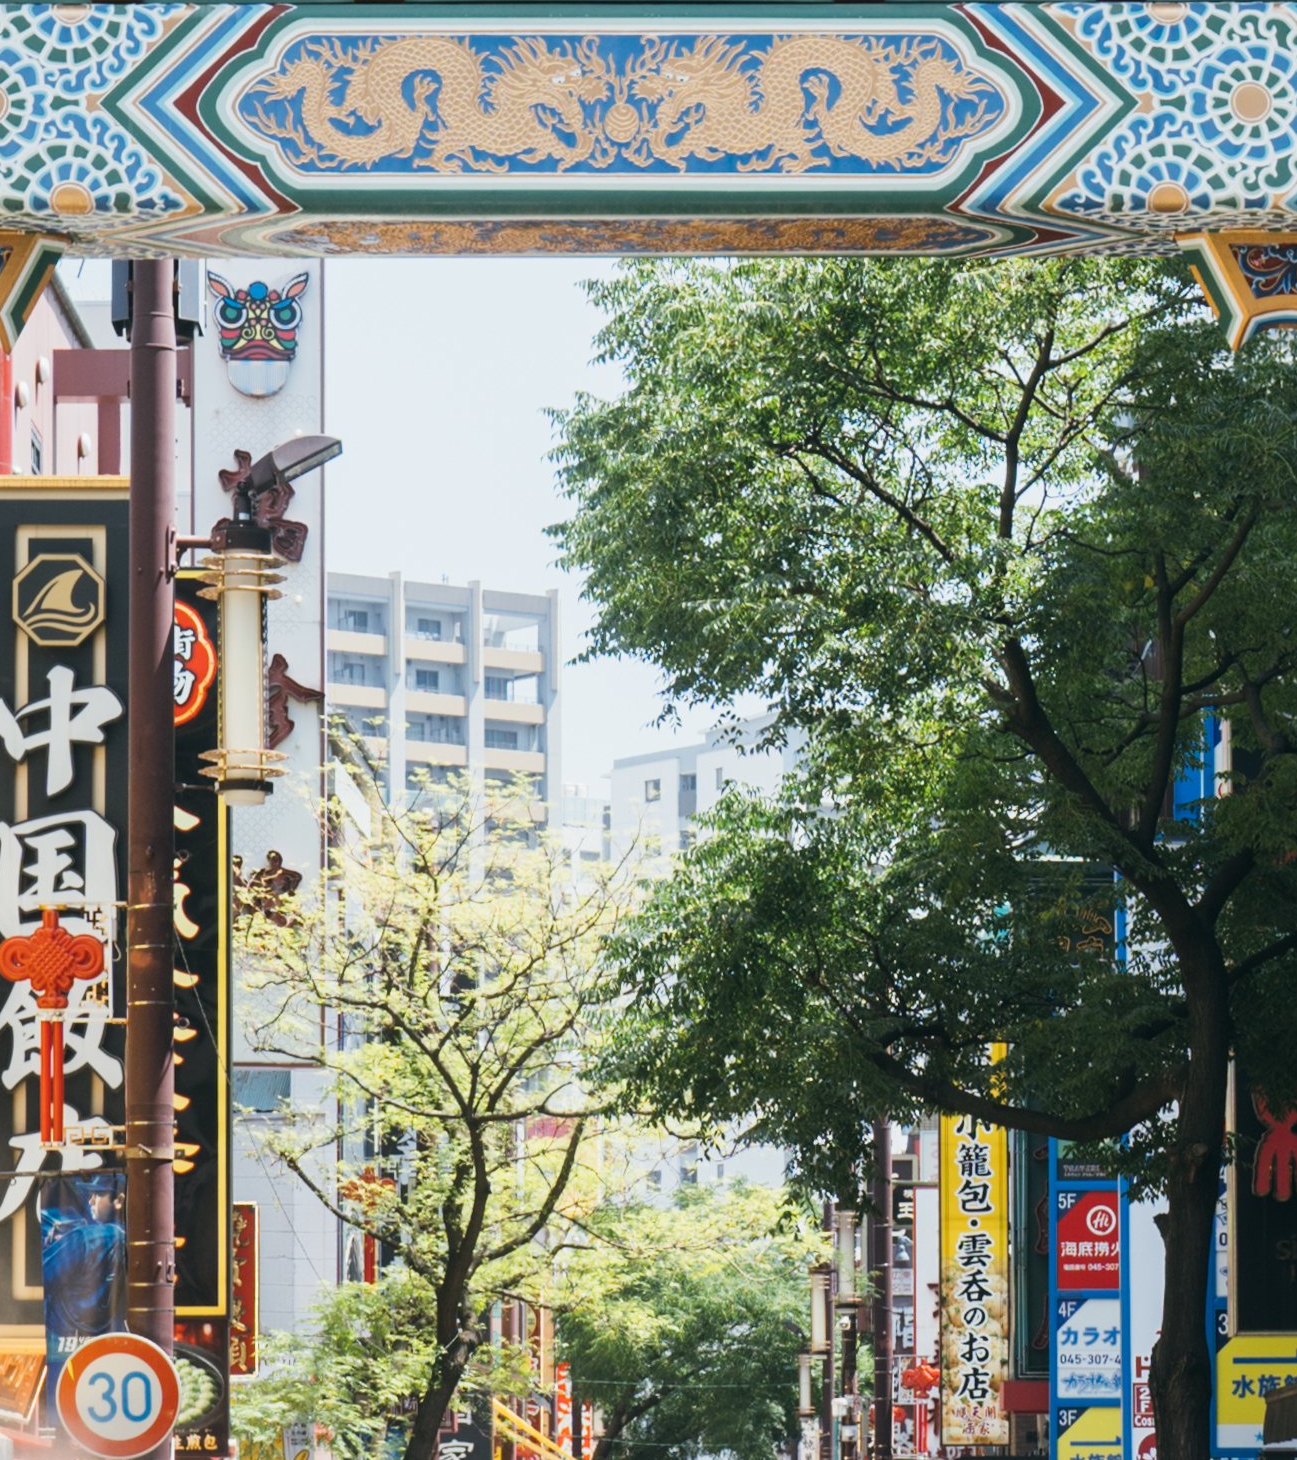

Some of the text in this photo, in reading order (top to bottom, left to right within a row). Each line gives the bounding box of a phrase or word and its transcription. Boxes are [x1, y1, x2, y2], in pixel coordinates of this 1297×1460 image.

[1057, 1192, 1077, 1210] 5F
[1057, 1301, 1077, 1319] 4F
[87, 1370, 153, 1423] 30
[1058, 1409, 1078, 1426] 3F
